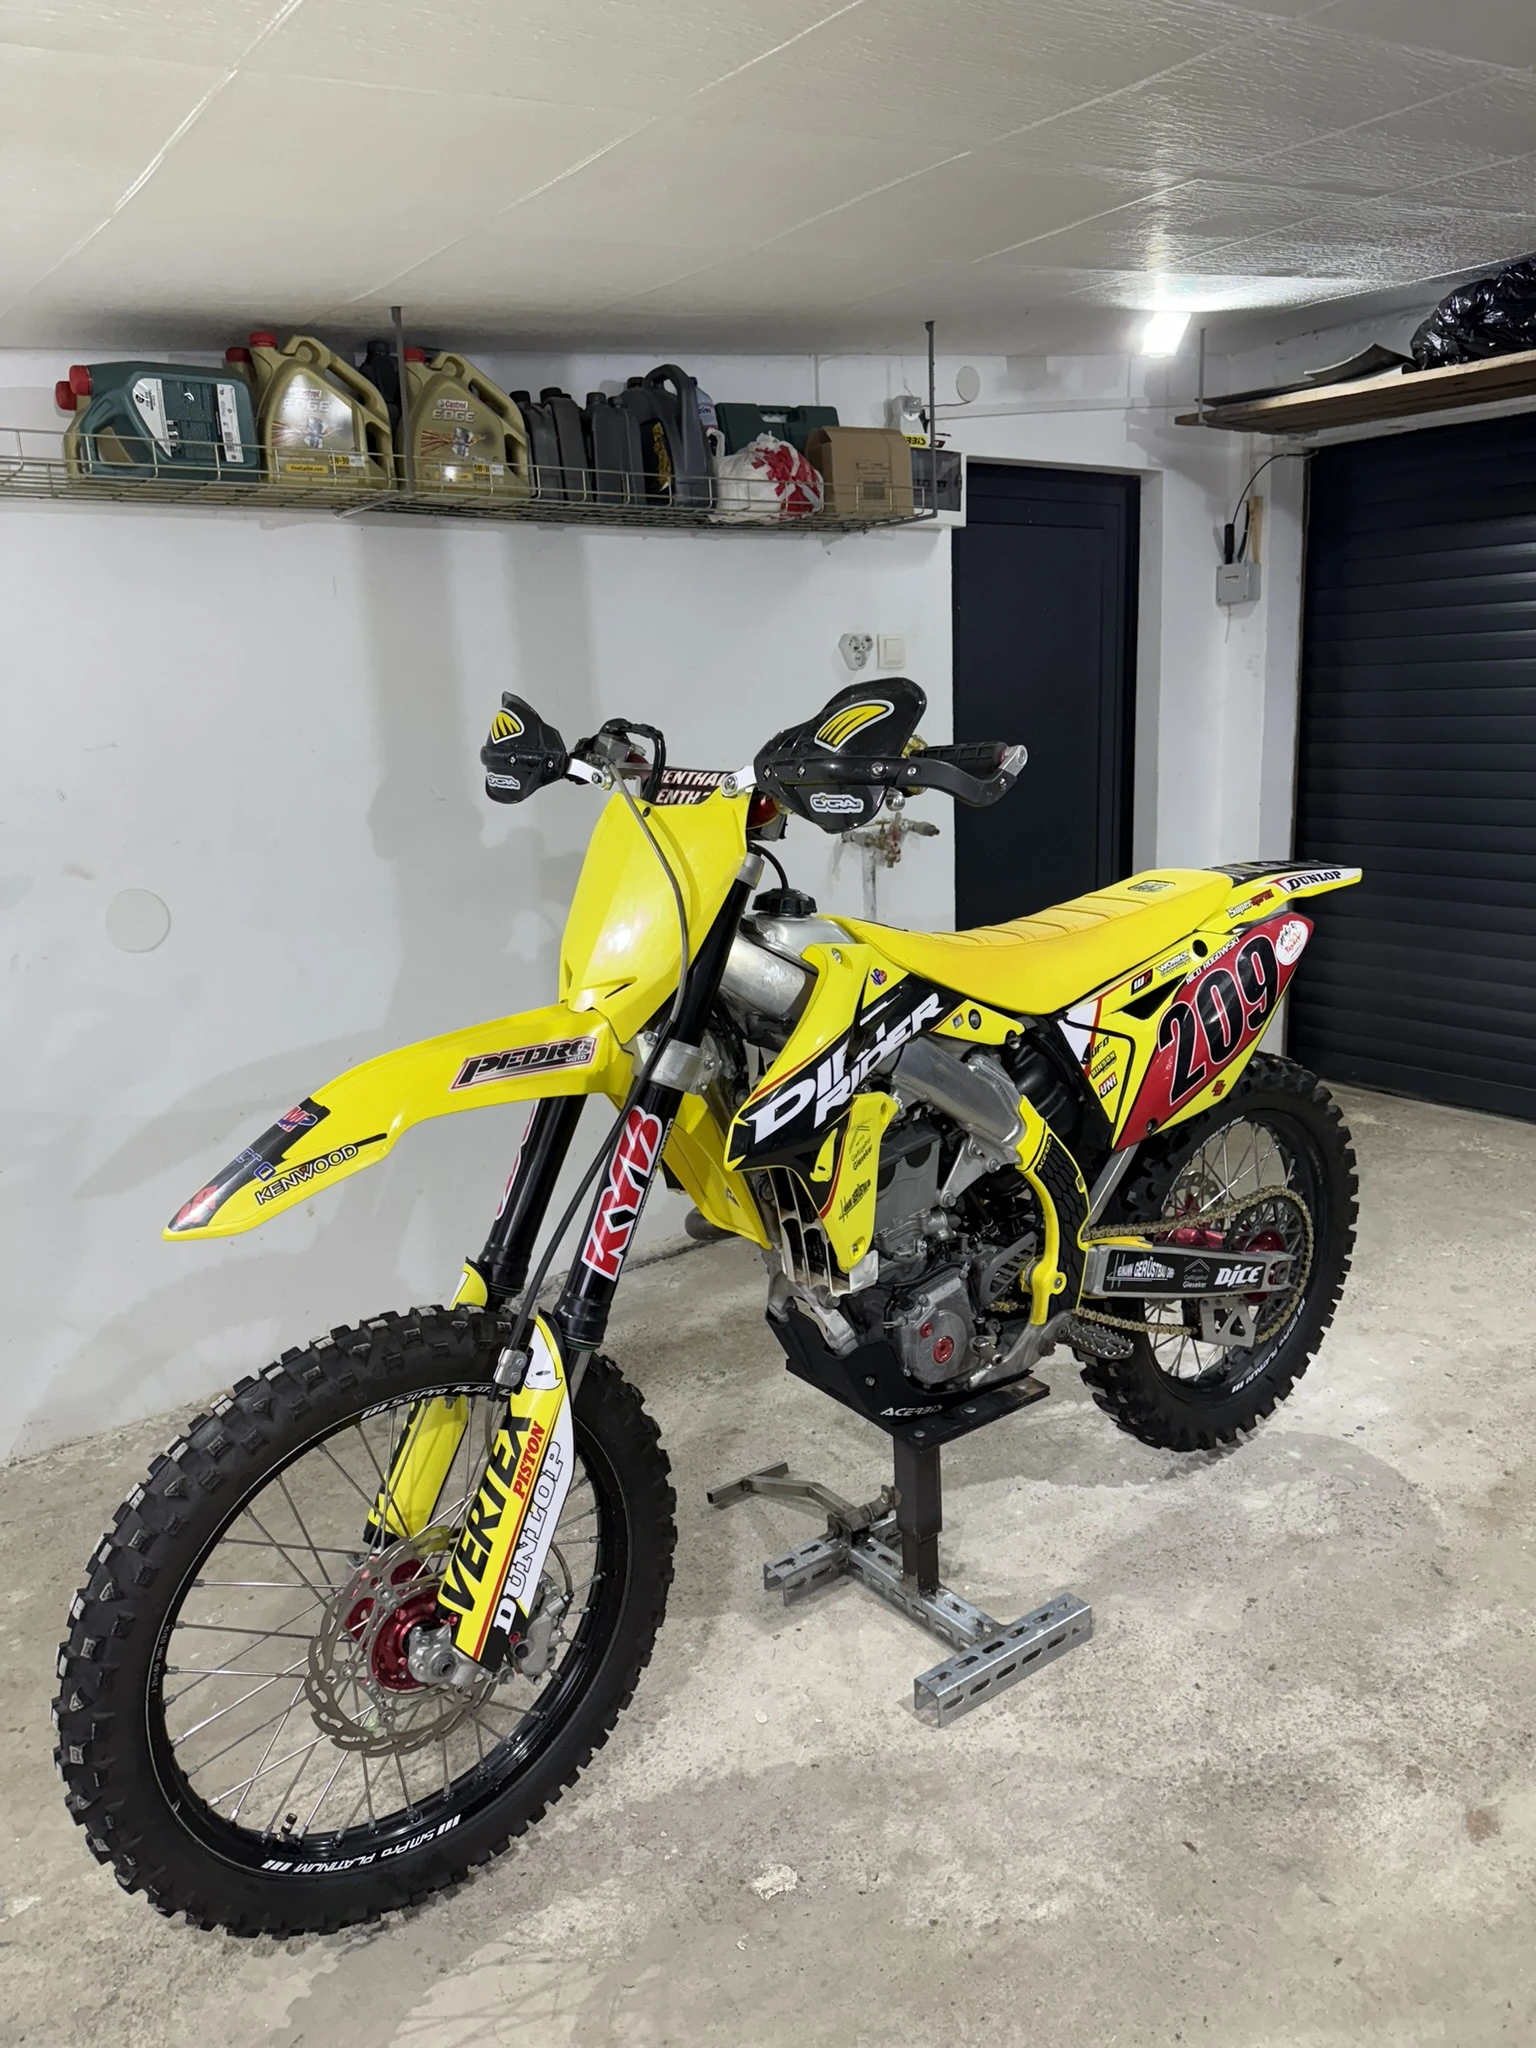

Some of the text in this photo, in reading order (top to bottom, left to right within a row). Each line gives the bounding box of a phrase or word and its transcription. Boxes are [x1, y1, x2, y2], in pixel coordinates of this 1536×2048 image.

[432, 409, 476, 422] EDGE
[445, 401, 467, 409] Castrol
[655, 789, 711, 804] ENTH
[1287, 870, 1342, 891] DUNLOP
[1158, 935, 1278, 1106] 209
[814, 993, 944, 1128] RIDER
[1100, 1074, 1117, 1096] UNI
[254, 1143, 359, 1206] KENWOOD
[581, 1105, 662, 1282] KYB
[512, 1421, 546, 1500] PISTON
[442, 1416, 532, 1612] VERTEX
[491, 1441, 562, 1635] DUNLOP
[293, 1852, 376, 1873] PLATINUM
